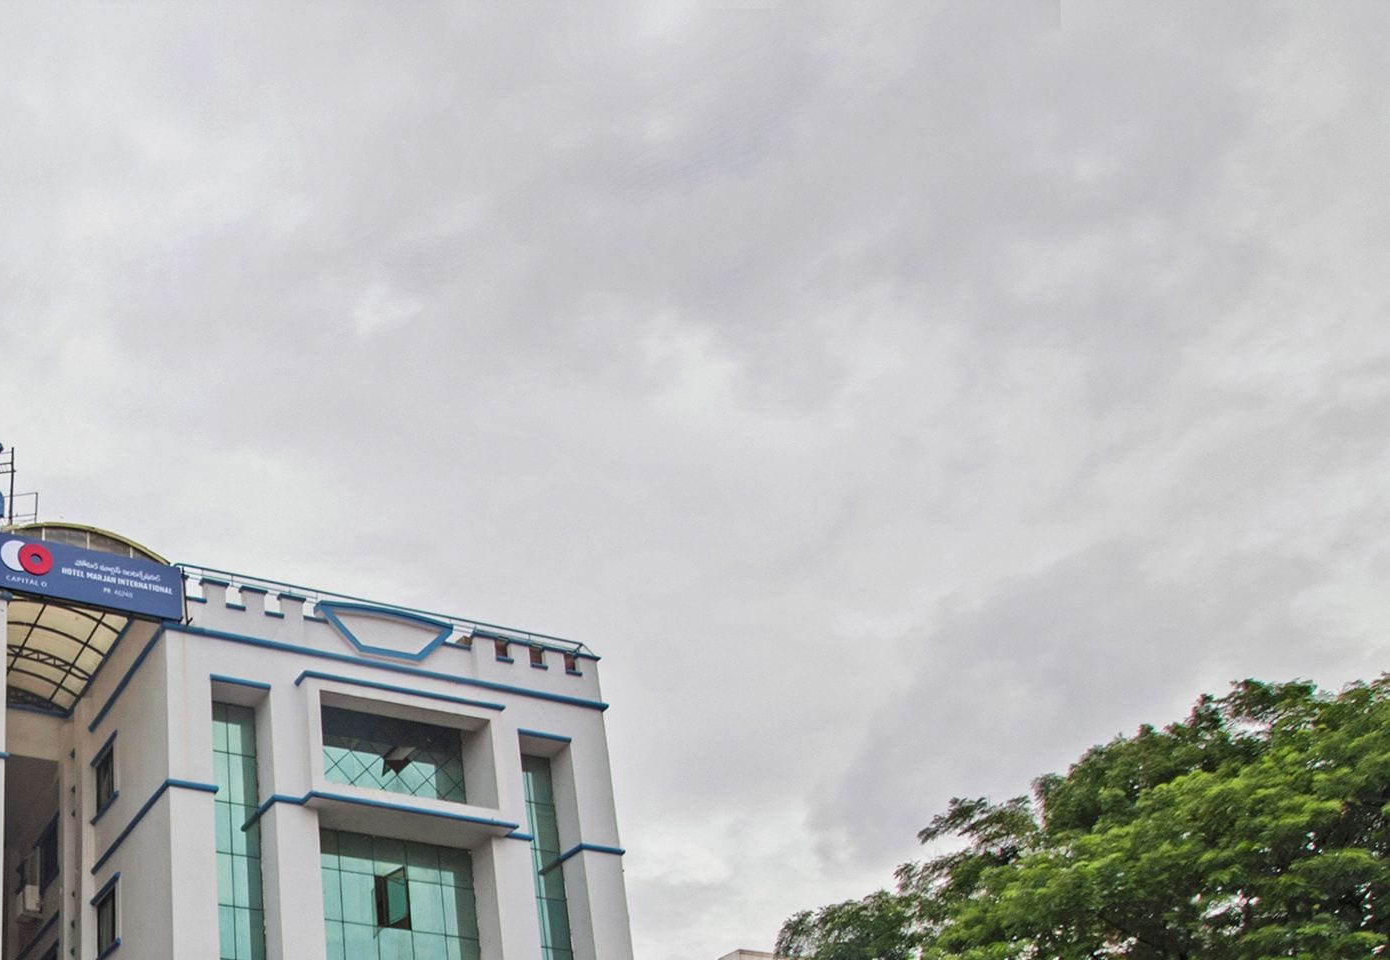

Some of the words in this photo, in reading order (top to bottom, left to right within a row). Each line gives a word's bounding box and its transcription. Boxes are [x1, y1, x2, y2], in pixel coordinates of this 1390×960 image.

[5, 575, 39, 587] CAPITAL
[61, 567, 85, 579] HOTEL
[86, 572, 116, 585] MARJAN
[117, 577, 174, 595] INTERNATIONAL
